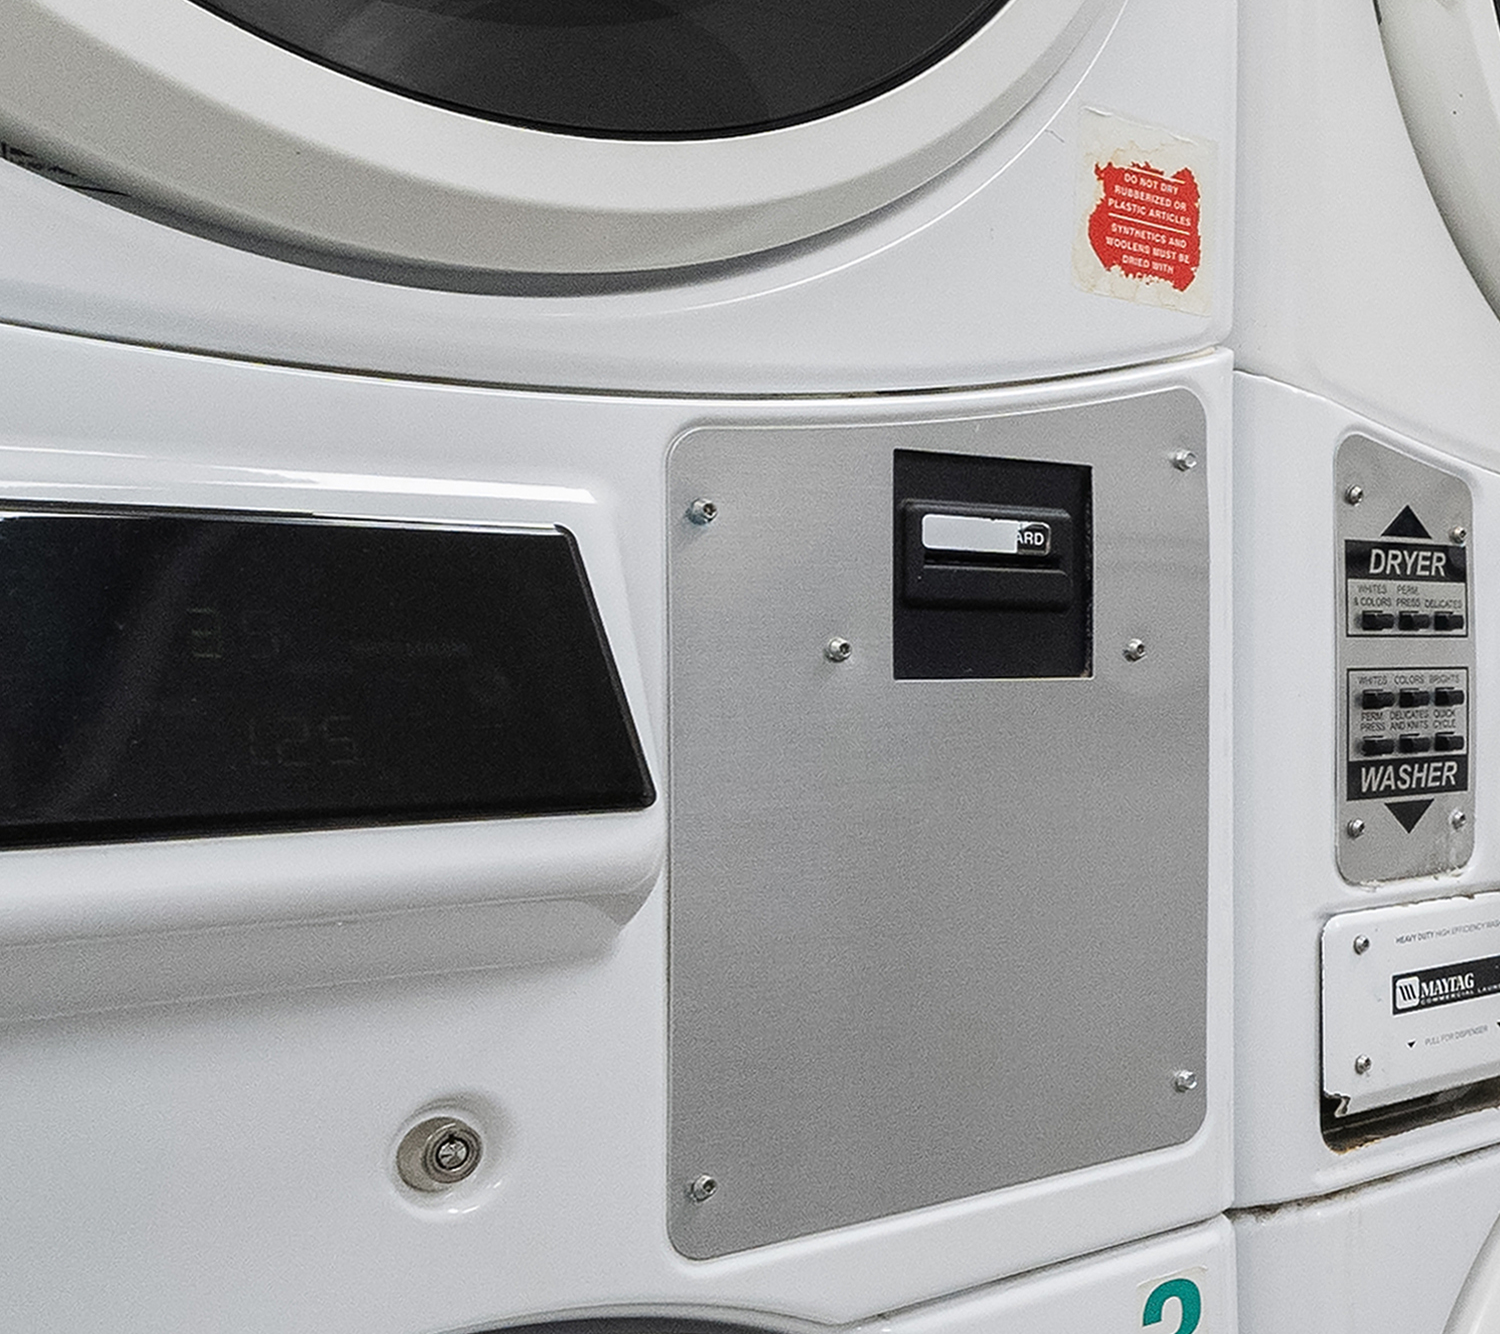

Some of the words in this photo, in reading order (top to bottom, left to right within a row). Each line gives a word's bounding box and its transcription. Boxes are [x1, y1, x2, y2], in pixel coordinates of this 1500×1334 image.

[1124, 173, 1138, 184] DO
[1140, 177, 1158, 190] NOT
[1160, 182, 1179, 195] DRY
[1114, 185, 1172, 208] RUBBERIZED
[1174, 200, 1187, 212] OR
[1107, 198, 1147, 215] PLASTIC
[1149, 207, 1192, 227] ARTICLES
[1111, 223, 1167, 245] SYNTHETICS
[1169, 237, 1187, 249] AND
[1105, 236, 1151, 255] WOOLENS
[1152, 247, 1176, 260] MUST
[1178, 253, 1190, 264] BE
[1122, 254, 1150, 268] DRIED
[1152, 261, 1175, 274] WITH
[1016, 532, 1045, 546] ARD
[1369, 548, 1447, 577] DRYER
[1360, 597, 1392, 607] COLORS
[1396, 597, 1421, 607] PRESS
[1424, 598, 1463, 609] DELICATES
[1394, 674, 1425, 685] COLORS
[1389, 710, 1430, 720] DELICATES
[1360, 761, 1458, 793] WASHER
[1418, 931, 1434, 941] DUTY
[1420, 972, 1475, 999] MAYTAG
[1420, 990, 1474, 1005] COMMERCIAL
